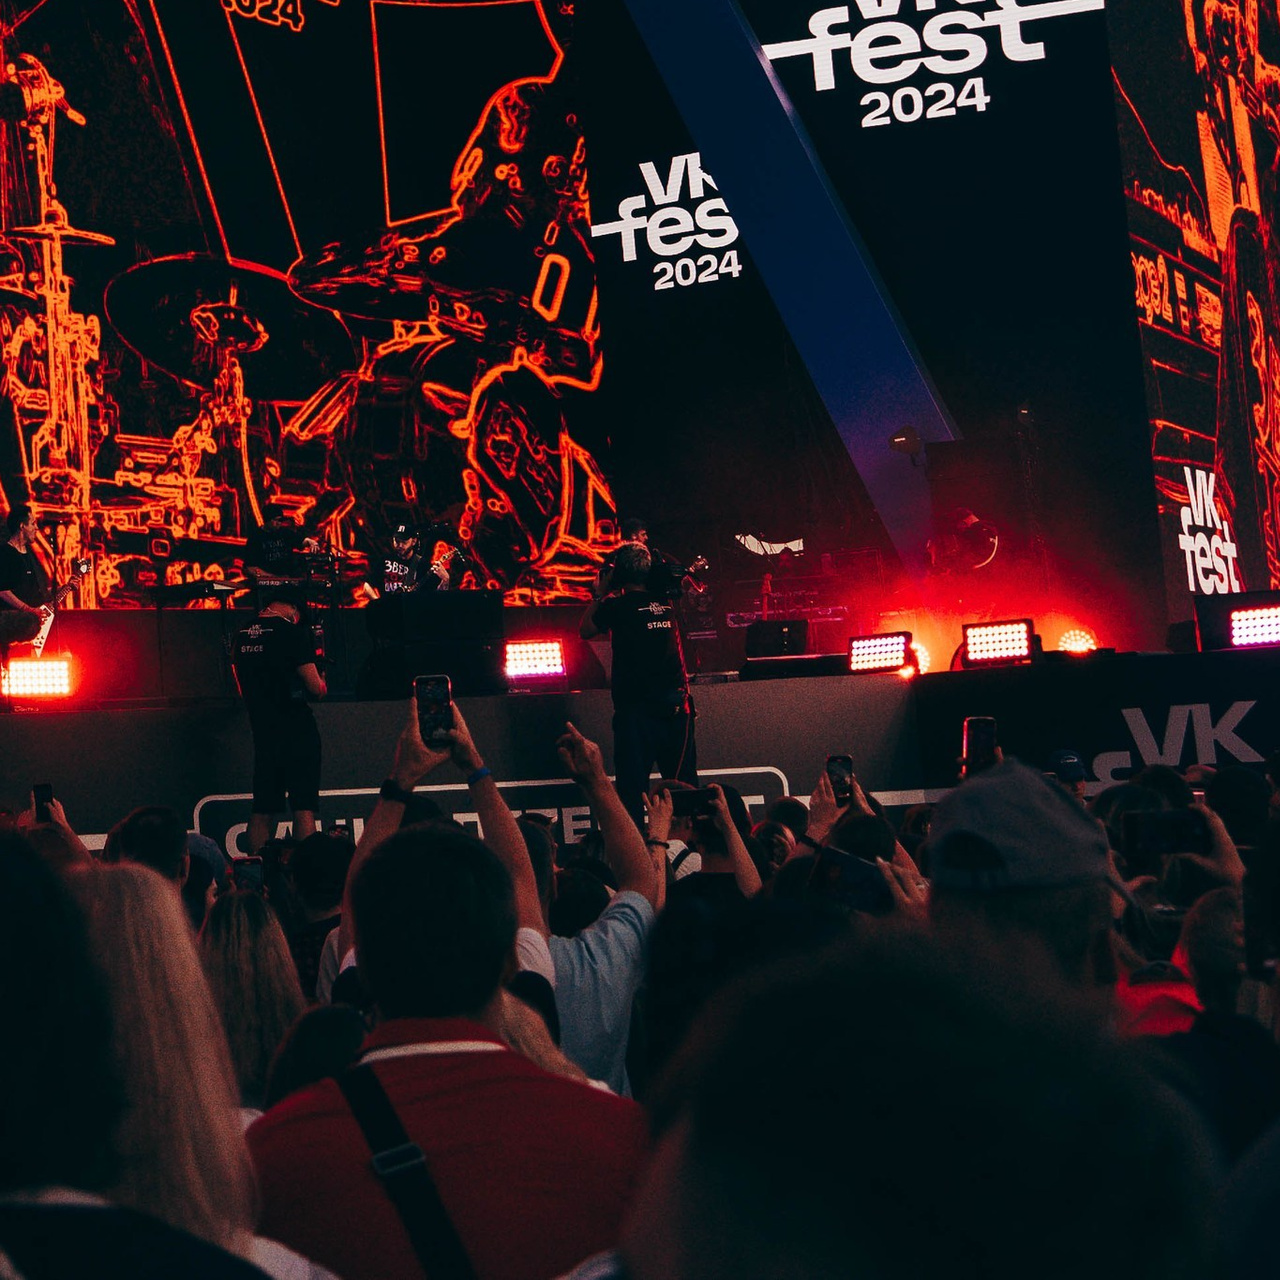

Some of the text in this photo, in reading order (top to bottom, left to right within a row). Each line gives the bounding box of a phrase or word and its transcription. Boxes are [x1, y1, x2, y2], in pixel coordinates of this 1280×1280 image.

[859, 77, 992, 130] 2024
[652, 250, 743, 291] 2024
[1183, 465, 1223, 530] VK
[1178, 506, 1241, 595] fest
[240, 645, 264, 653] STAGE
[647, 620, 672, 629] STAGE
[1121, 700, 1266, 767] VK
